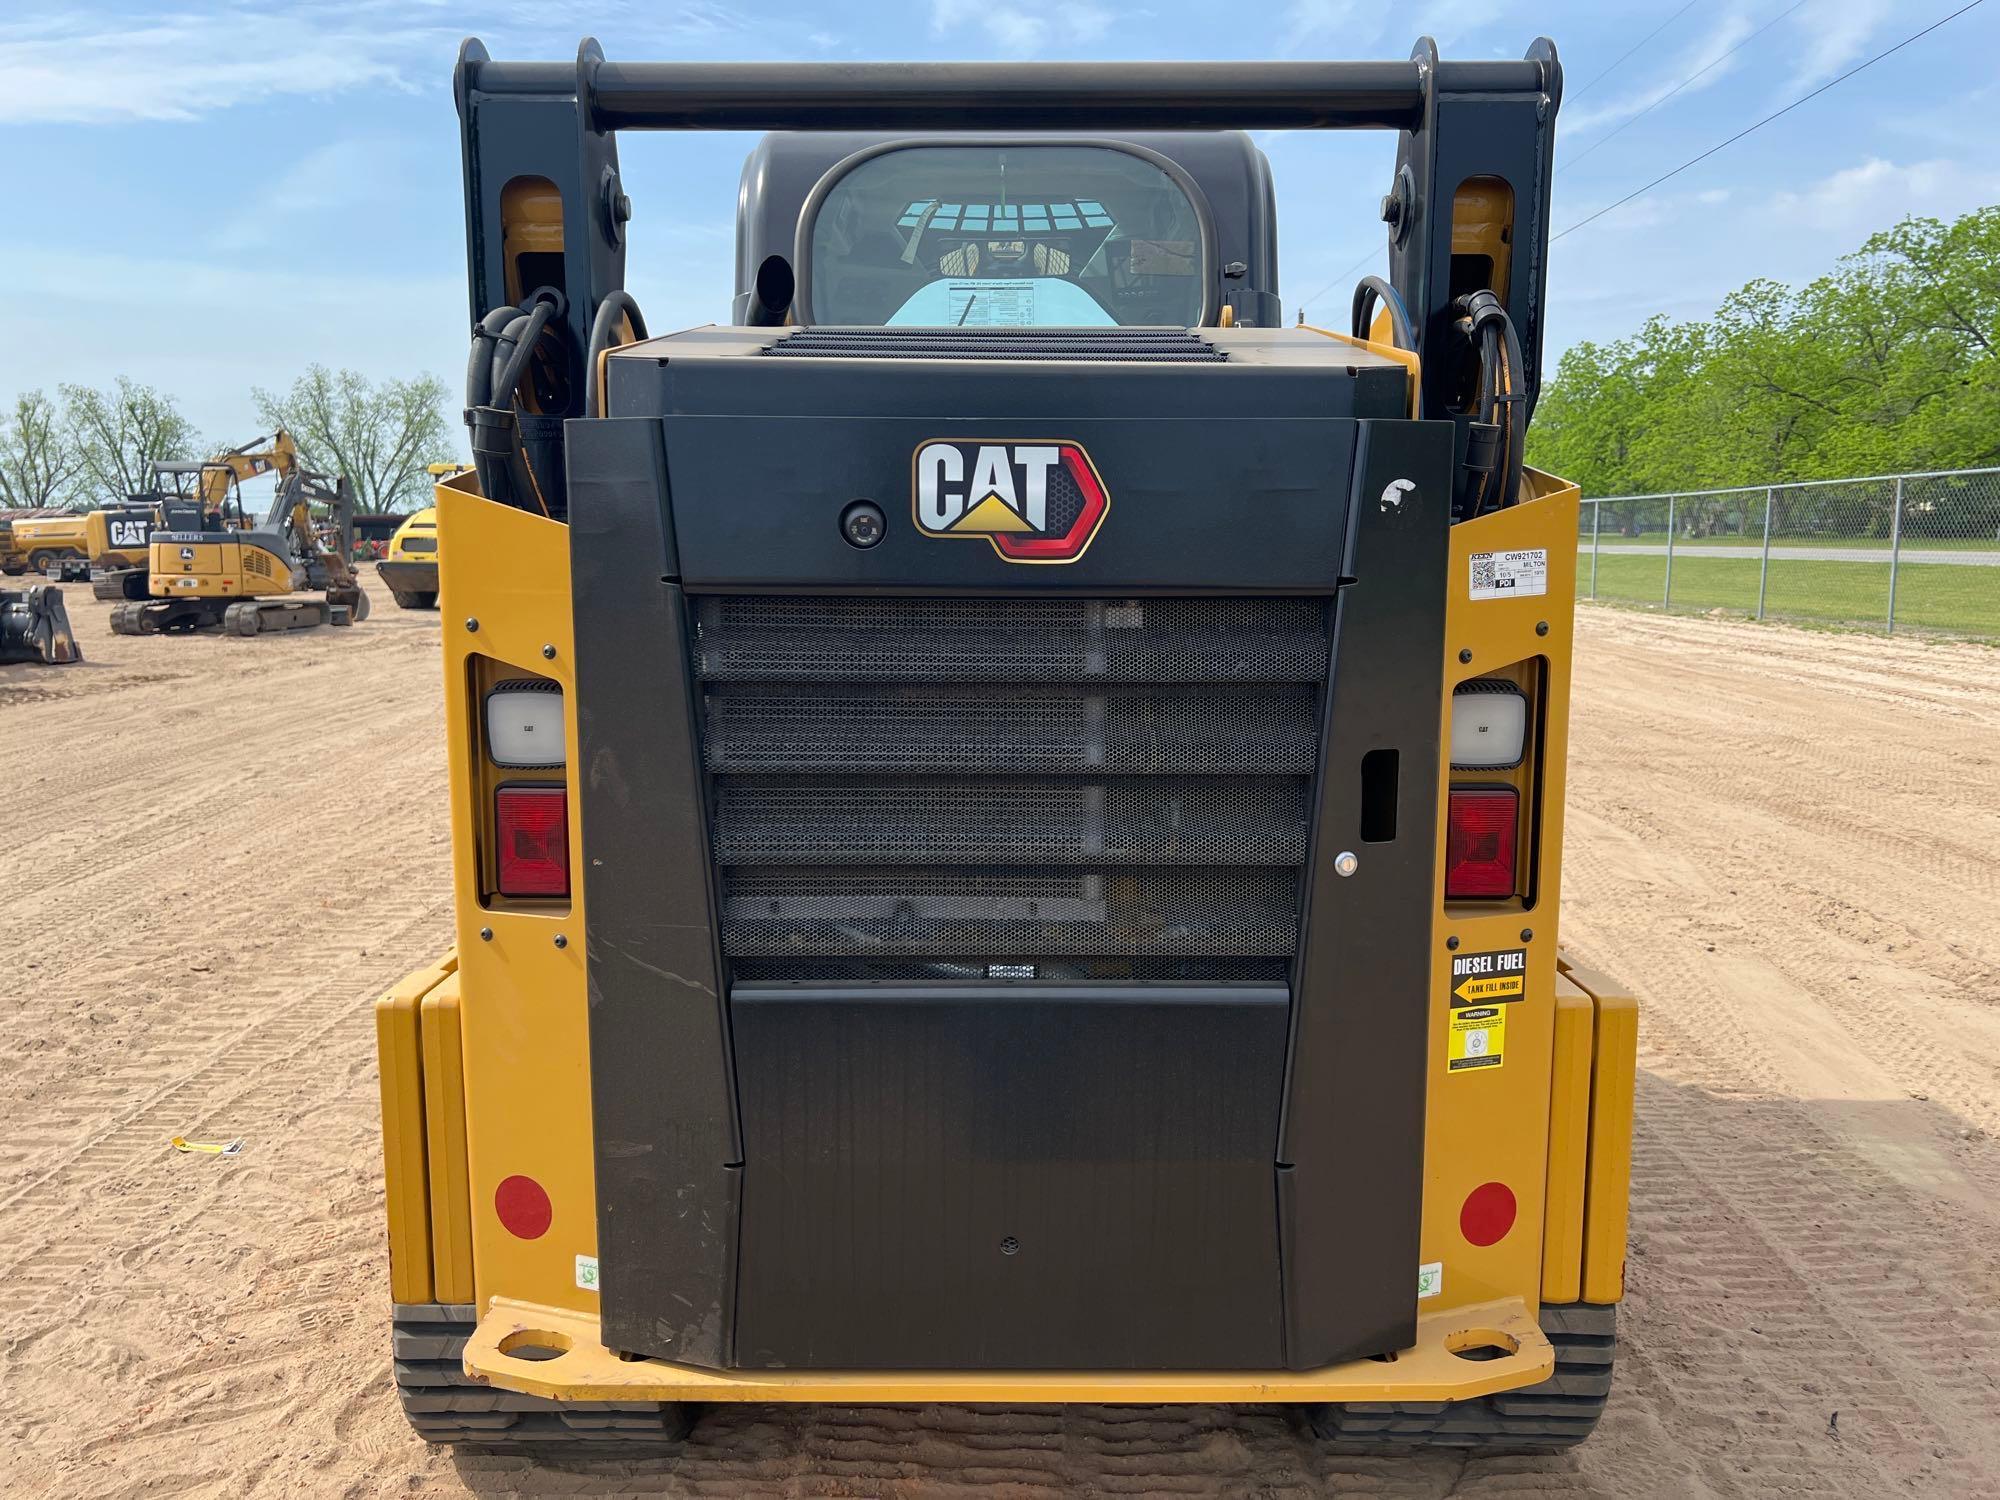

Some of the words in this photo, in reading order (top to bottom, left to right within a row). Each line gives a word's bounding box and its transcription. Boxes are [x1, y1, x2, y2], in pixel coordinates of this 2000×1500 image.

[919, 443, 1059, 532] CAT
[111, 521, 147, 545] CAT
[1505, 551, 1543, 561] CW921702
[1499, 579, 1511, 587] PDI
[1453, 956, 1493, 975] DIESEL
[1497, 952, 1524, 971] FUEL
[1467, 985, 1484, 994] TANK
[1486, 983, 1498, 992] FILL
[1499, 980, 1519, 991] INSIDE
[1465, 1010, 1491, 1018] WARNING
